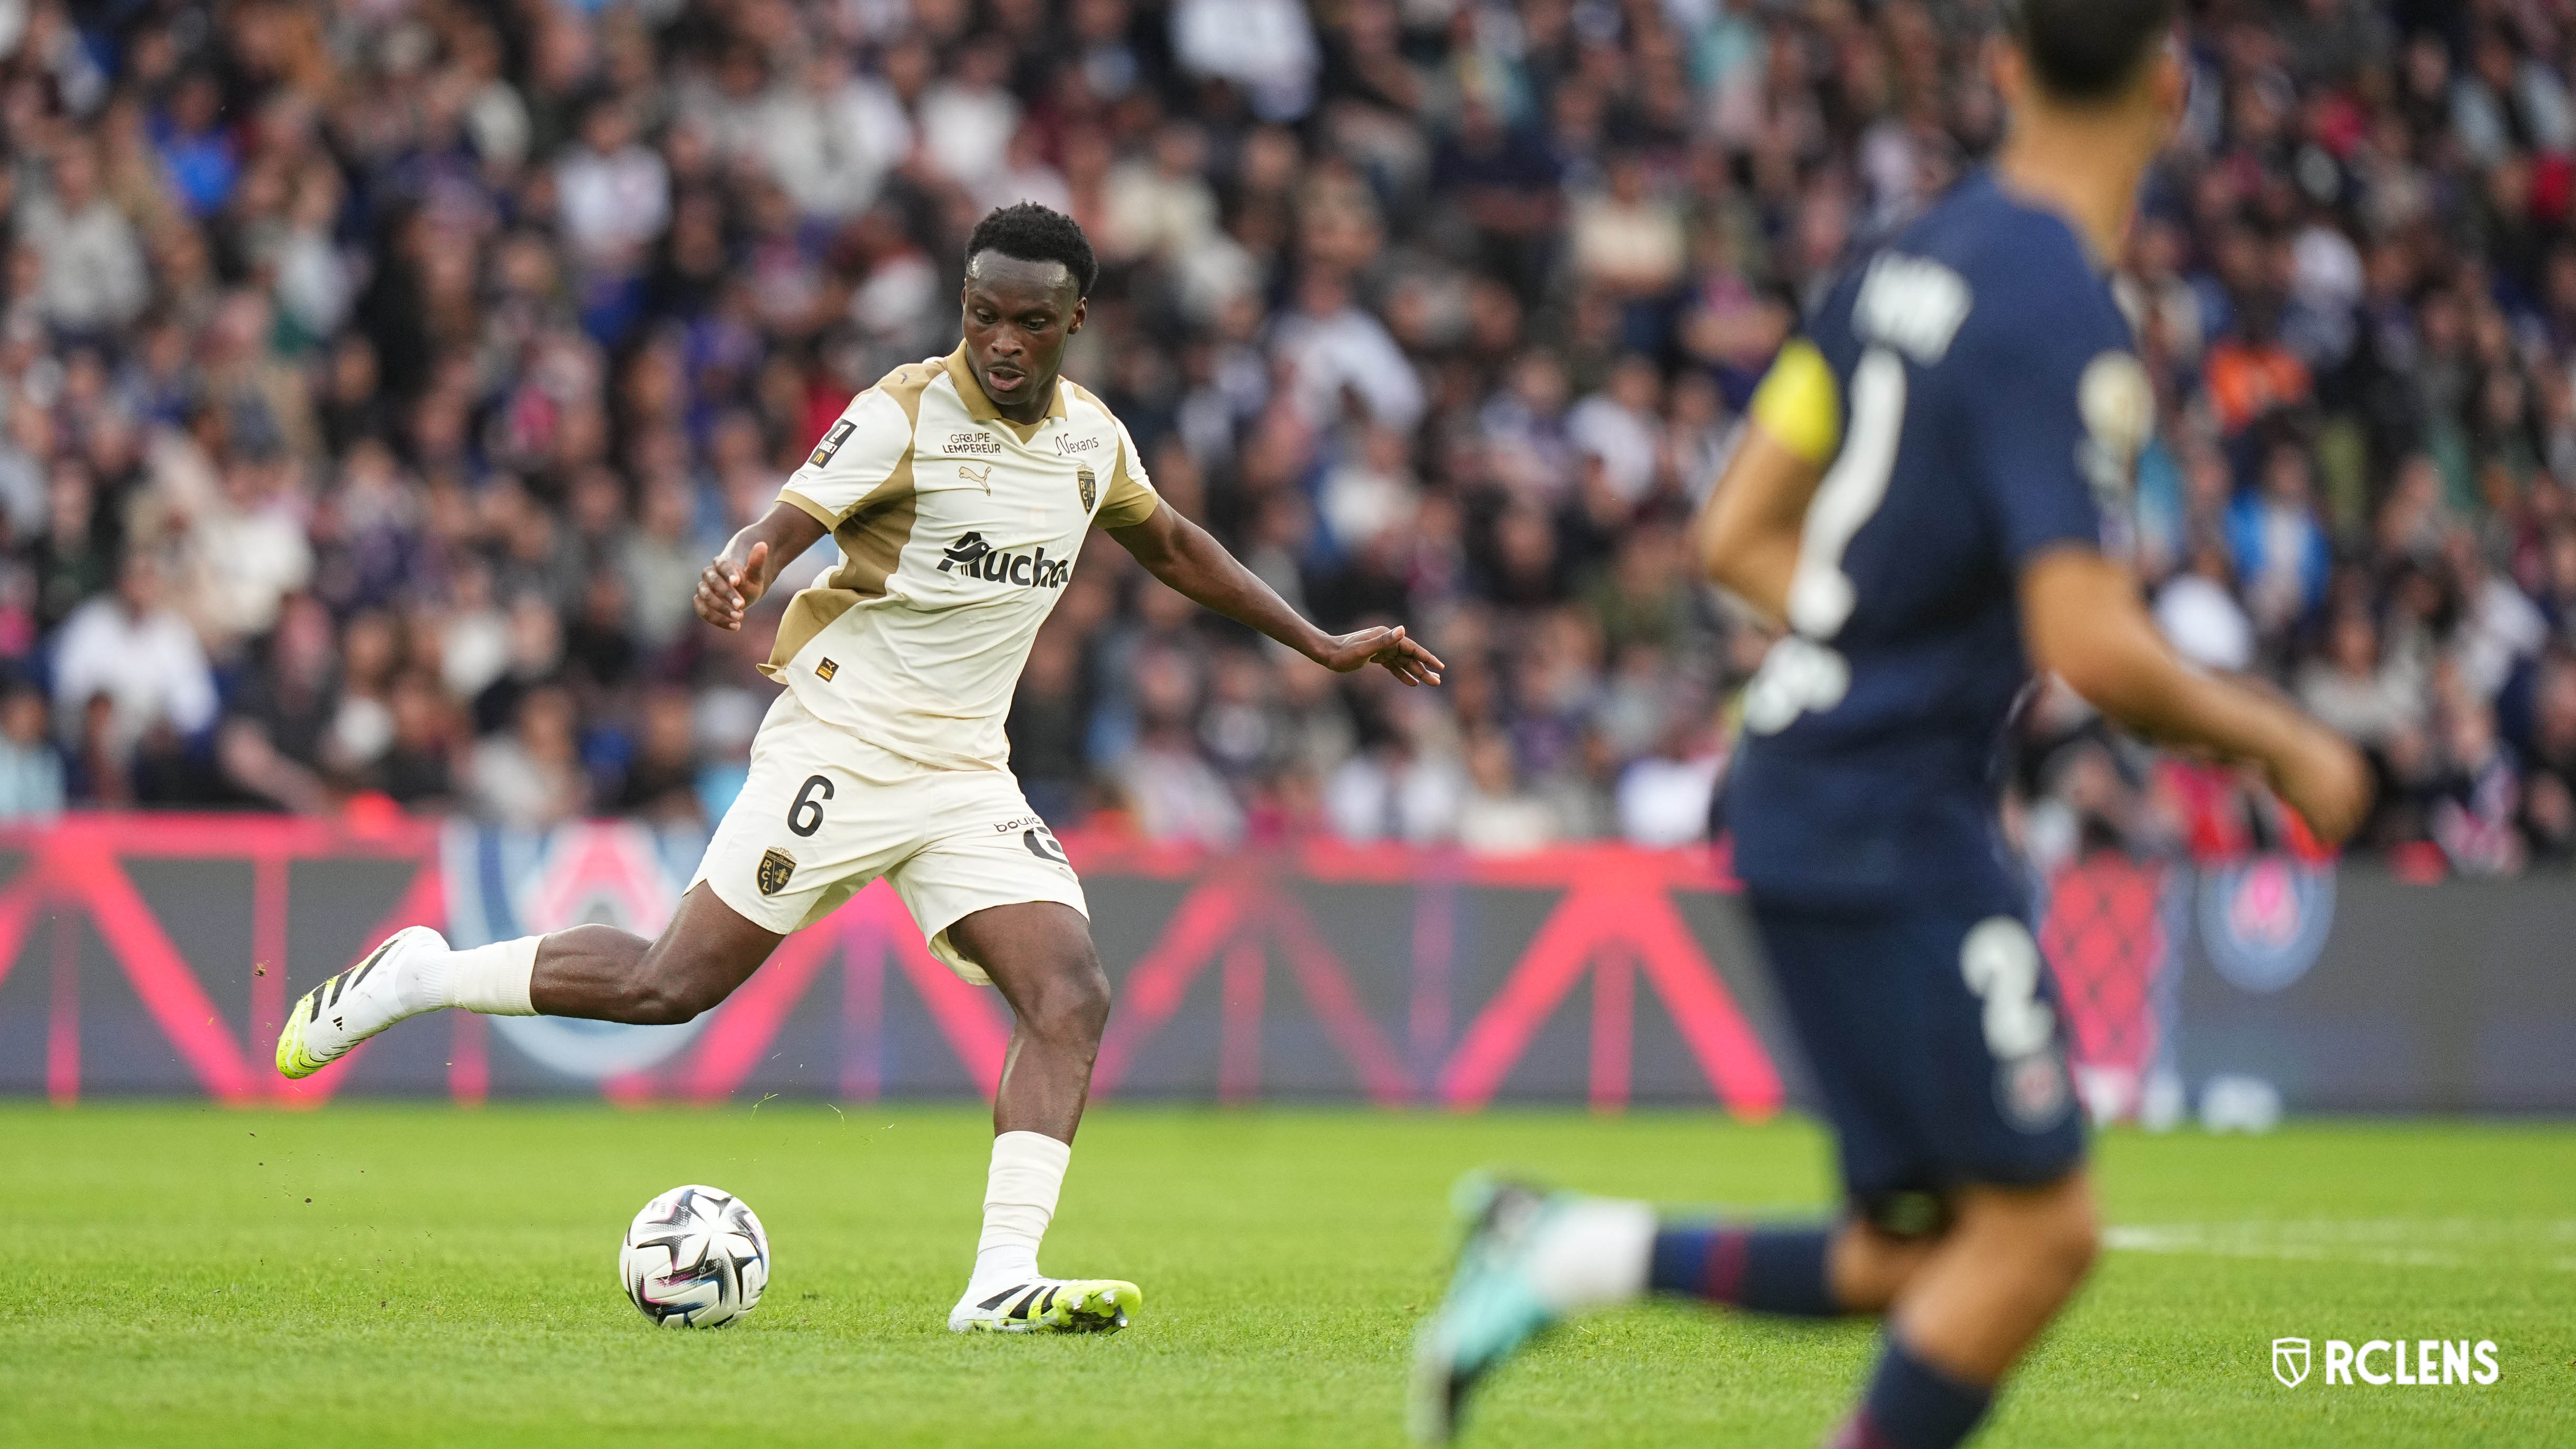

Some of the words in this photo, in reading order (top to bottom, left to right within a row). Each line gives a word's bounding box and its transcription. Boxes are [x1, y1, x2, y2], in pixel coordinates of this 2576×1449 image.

[942, 443, 1001, 453] LEMPEREUR
[950, 432, 990, 443] GROUPE
[1055, 433, 1099, 456] Nexans
[787, 774, 835, 837] 6
[1959, 915, 2055, 1058] 2
